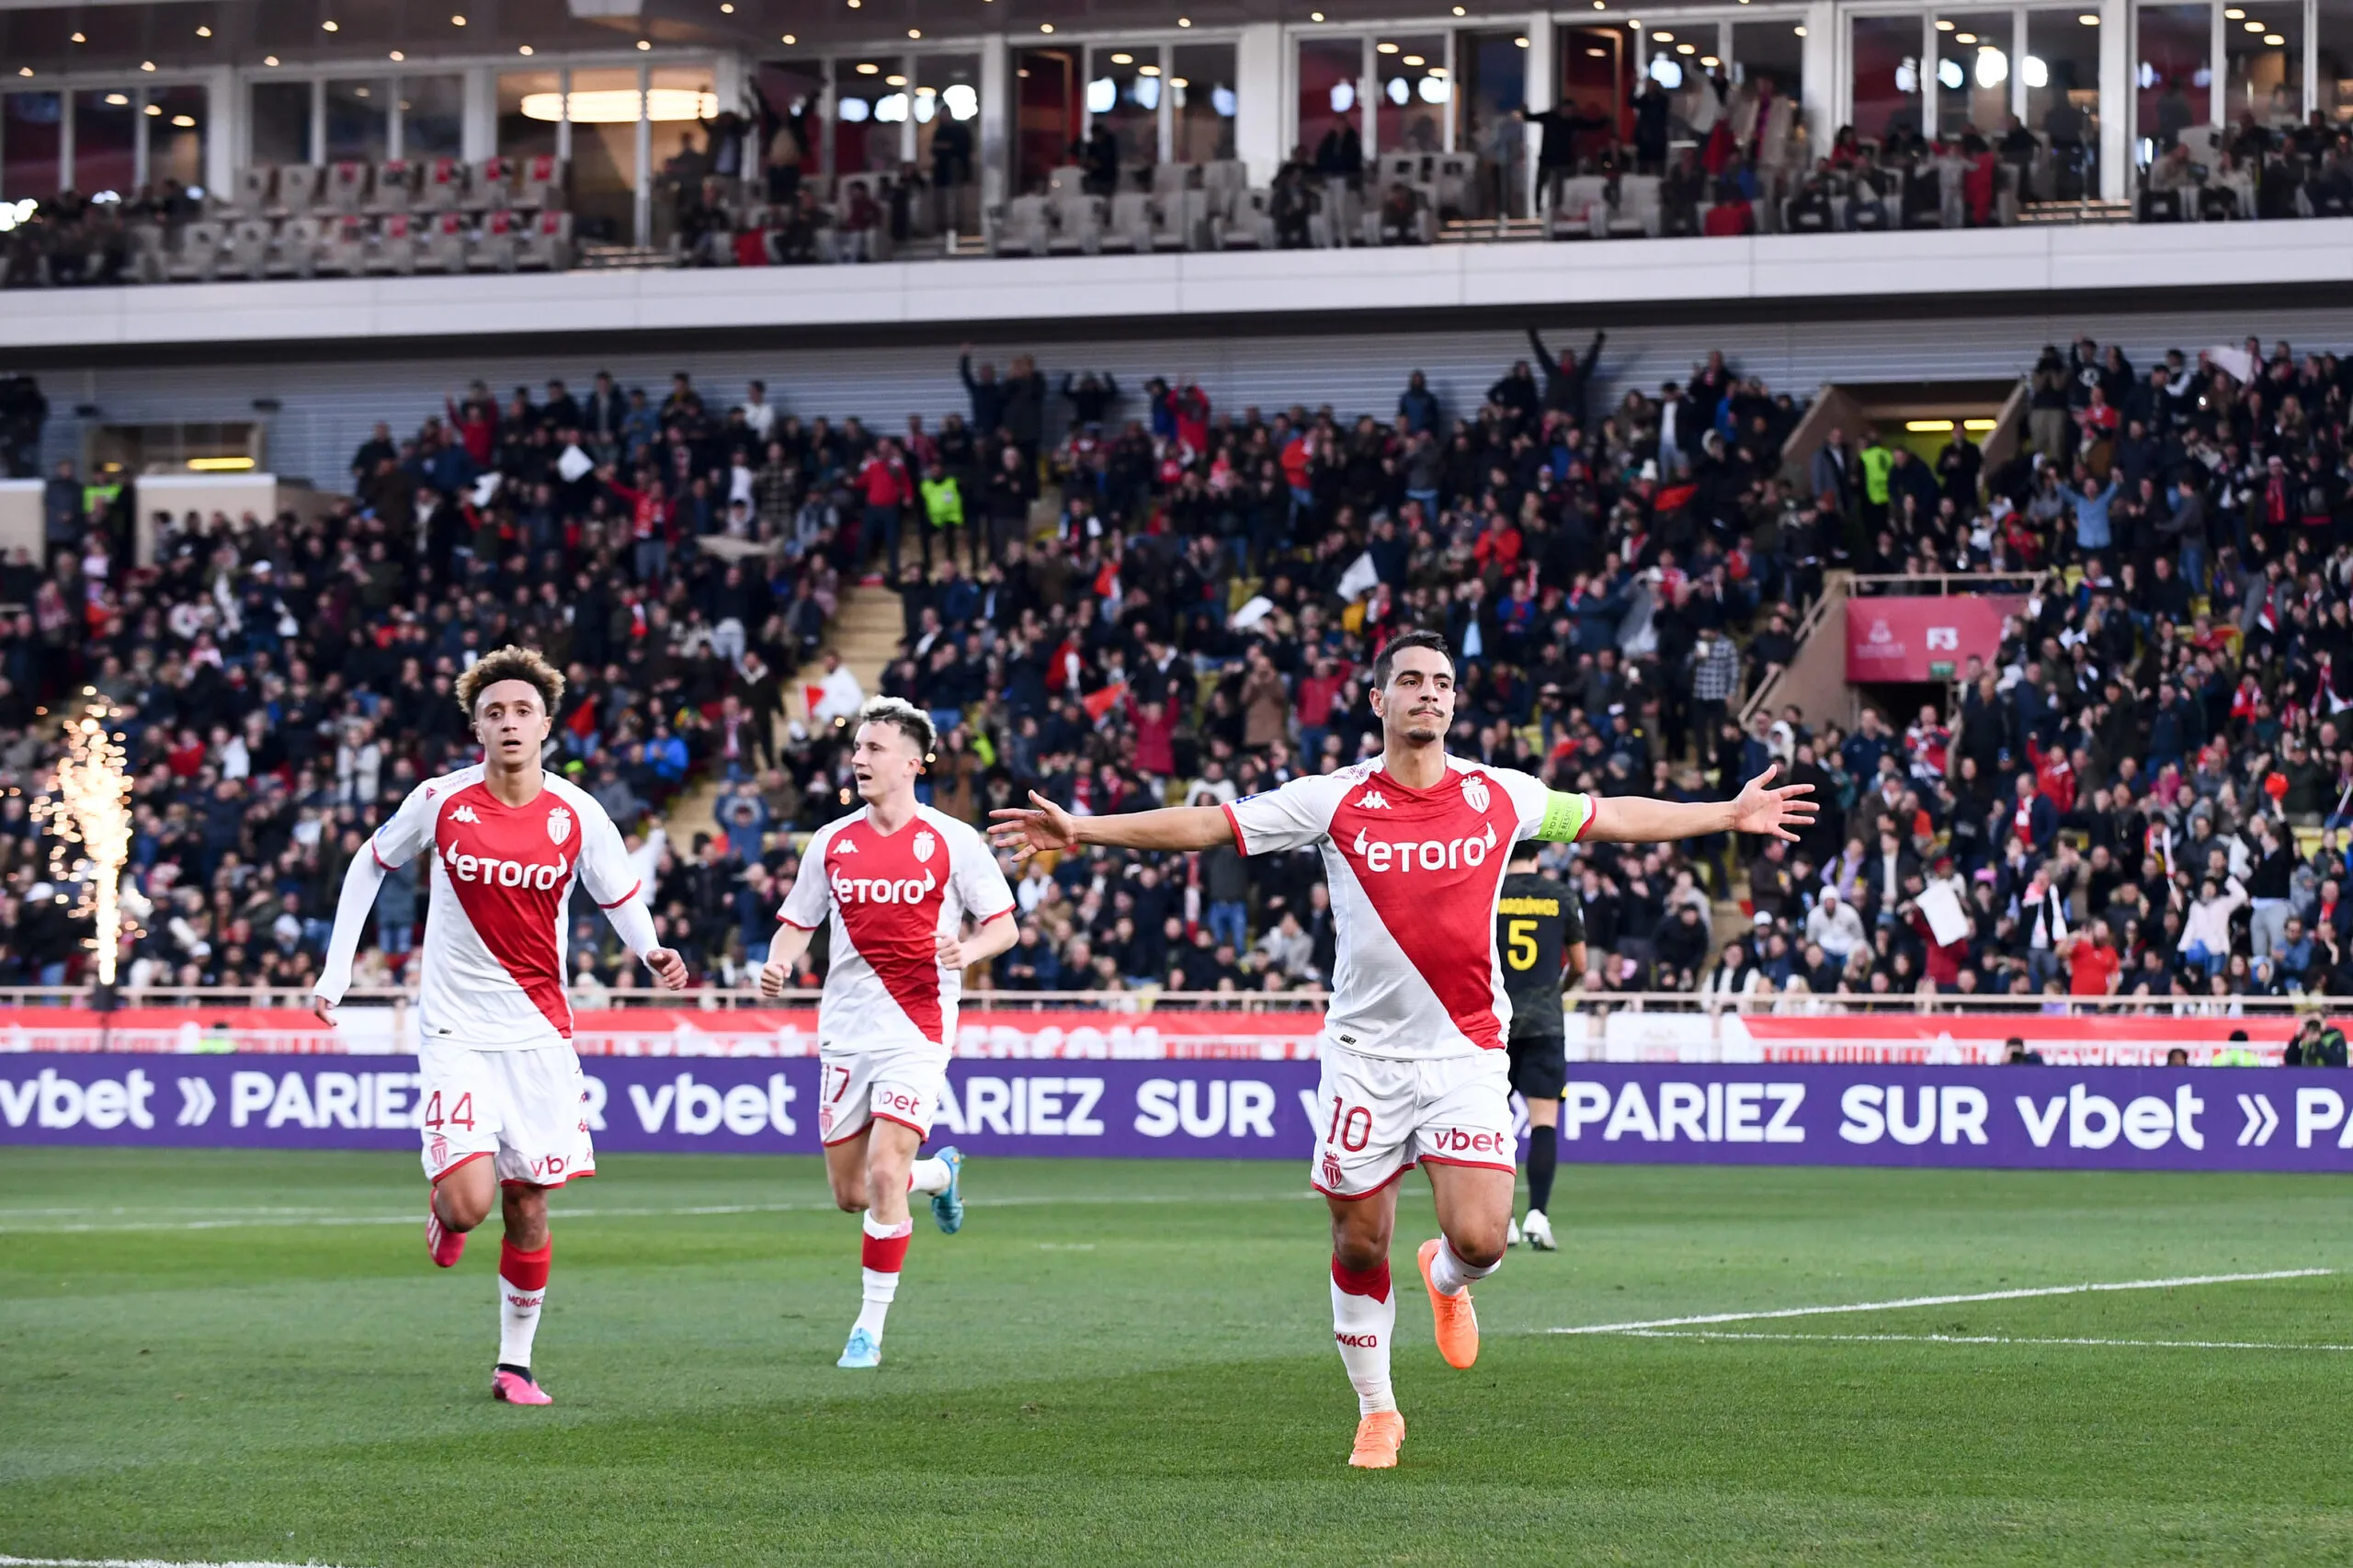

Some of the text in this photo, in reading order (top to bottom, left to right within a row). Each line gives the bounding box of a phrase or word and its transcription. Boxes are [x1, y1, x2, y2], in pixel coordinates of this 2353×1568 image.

[1927, 627, 1959, 651] F3
[1507, 919, 1538, 971] 5
[823, 1063, 850, 1103] 17
[0, 1068, 155, 1130] vbet
[231, 1071, 422, 1130] PARIE
[629, 1073, 797, 1136] vbet
[932, 1076, 1105, 1136] ARIEZ
[1134, 1078, 1276, 1138] SUR
[1565, 1081, 1806, 1142] PARIEZ
[1838, 1084, 1989, 1145] SUR
[2018, 1083, 2204, 1151] vbet
[426, 1090, 475, 1131] 44
[1326, 1095, 1372, 1153] 10
[1434, 1127, 1505, 1155] vbet
[529, 1154, 572, 1177] vb
[507, 1293, 543, 1307] MONAC
[1333, 1331, 1378, 1348] ONACO
